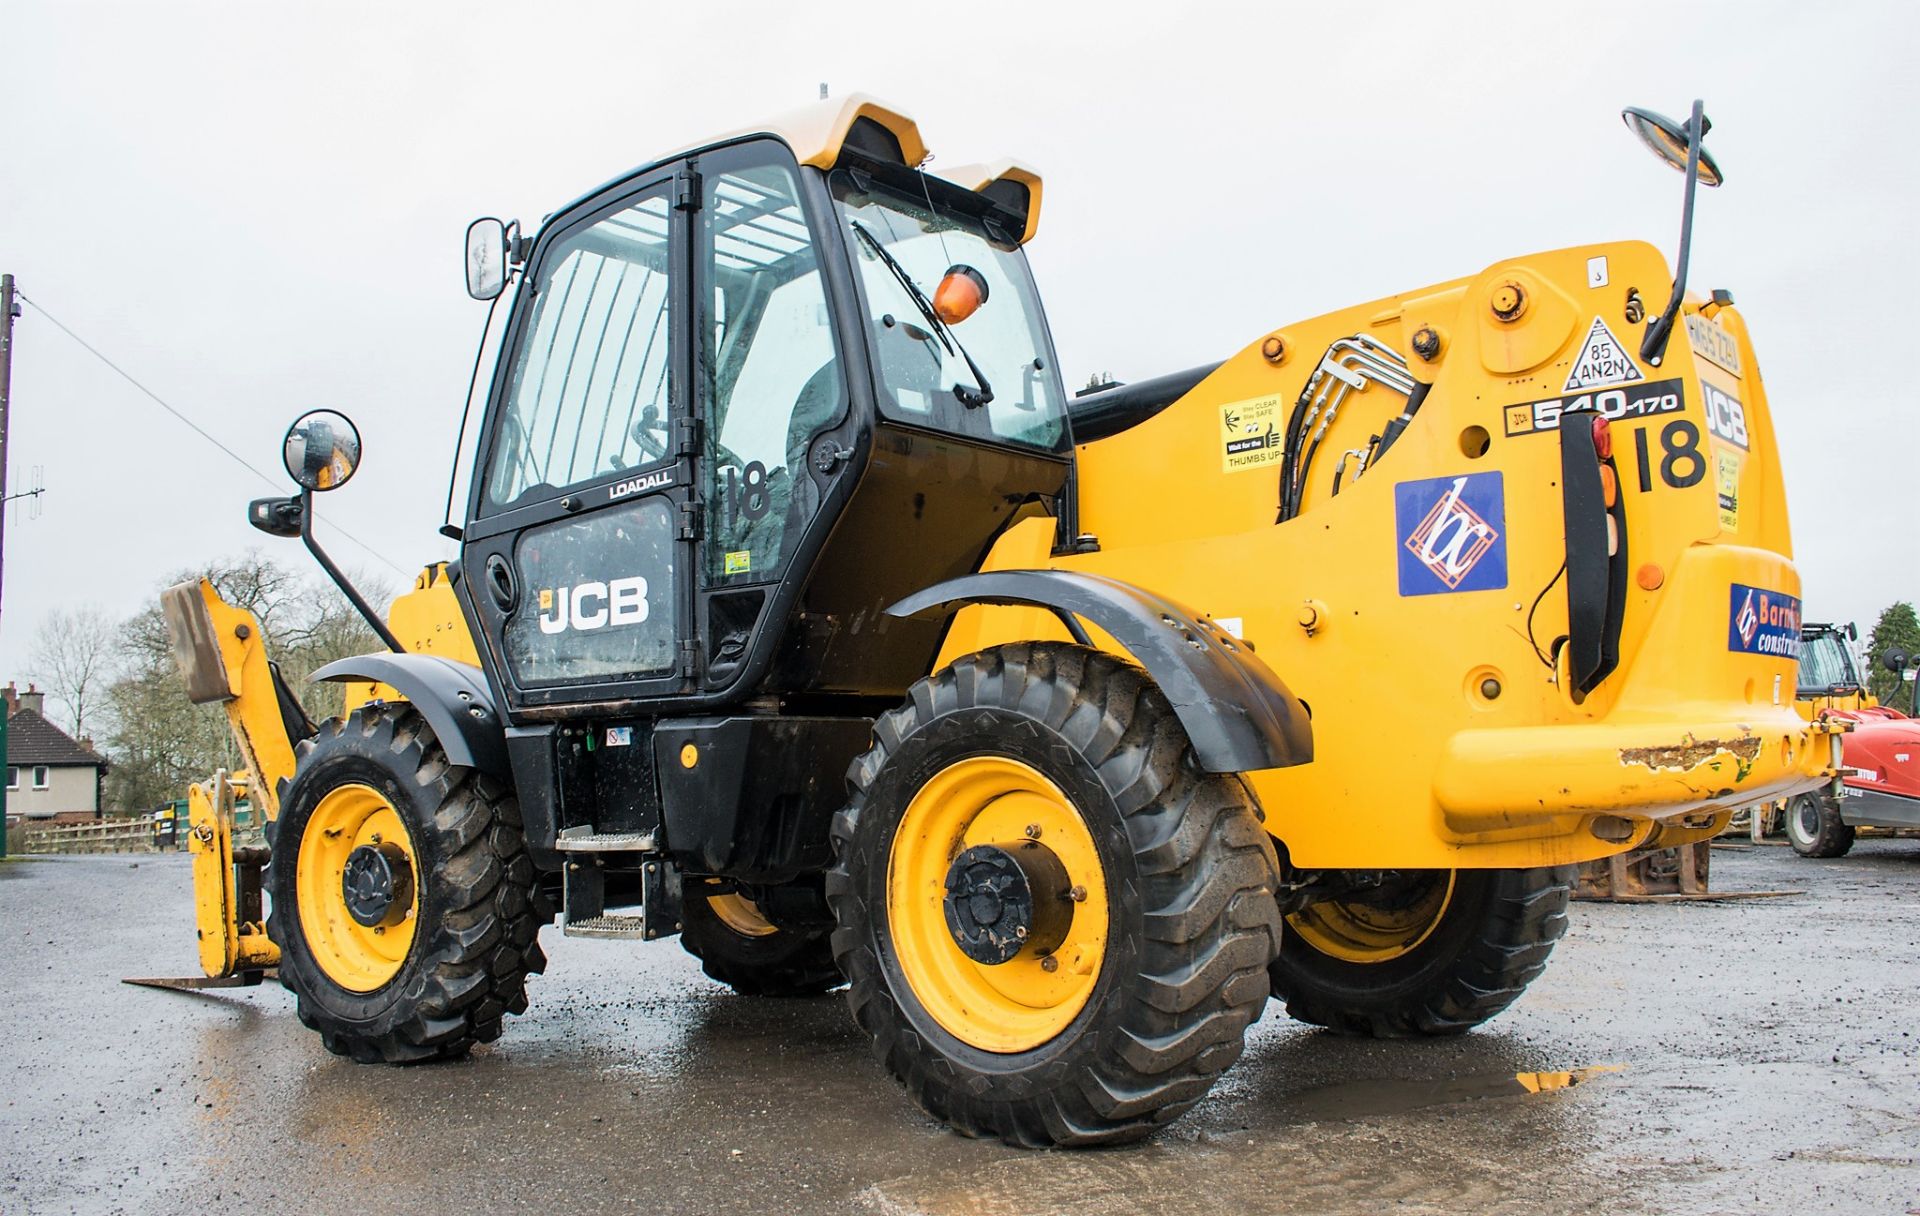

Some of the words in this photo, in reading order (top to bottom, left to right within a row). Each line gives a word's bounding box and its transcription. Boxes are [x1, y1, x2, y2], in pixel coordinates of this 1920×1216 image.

[1591, 343, 1611, 360] 85
[1582, 359, 1625, 380] AN2N
[1255, 400, 1277, 409] CLEAR
[1255, 409, 1273, 417] SAFE
[1705, 384, 1748, 447] JCB
[1229, 453, 1266, 467] THUMBS
[1267, 451, 1281, 460] UP
[1634, 419, 1707, 493] 18
[609, 471, 673, 500] LOADALL
[727, 460, 771, 526] 18
[539, 576, 650, 634] JCB
